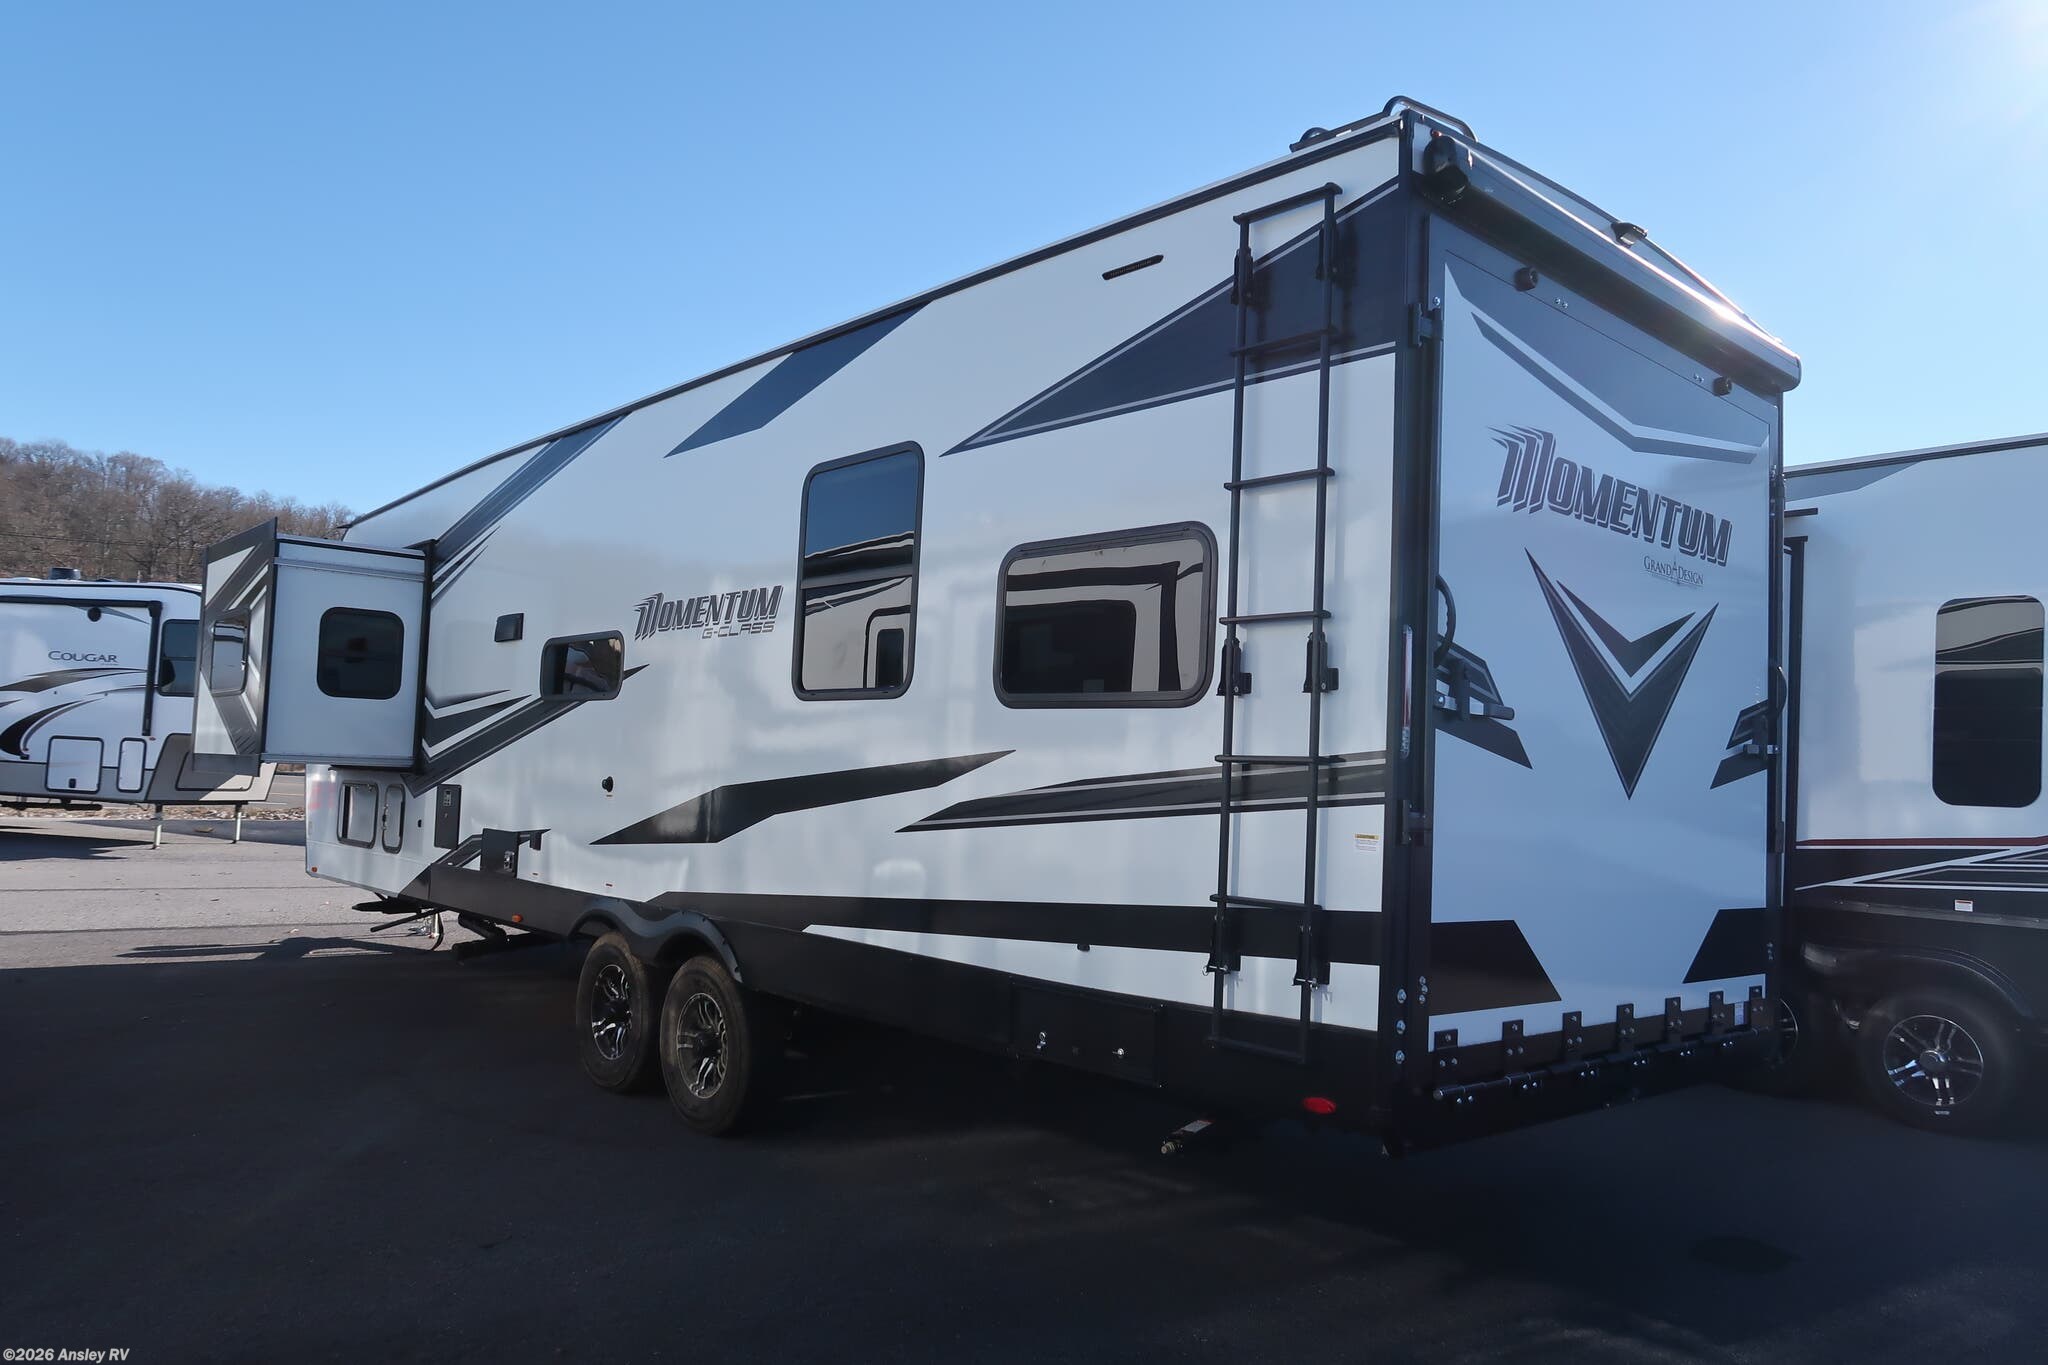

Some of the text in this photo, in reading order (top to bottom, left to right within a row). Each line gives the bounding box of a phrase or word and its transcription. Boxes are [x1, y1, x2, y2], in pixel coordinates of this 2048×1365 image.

[1486, 424, 1733, 567] MOMENTUM
[1644, 556, 1672, 575] GRAND
[1678, 566, 1704, 584] DESIGN
[632, 585, 784, 640] MOMENTUM
[701, 620, 776, 639] G-CLASS
[48, 650, 117, 664] COUGAR
